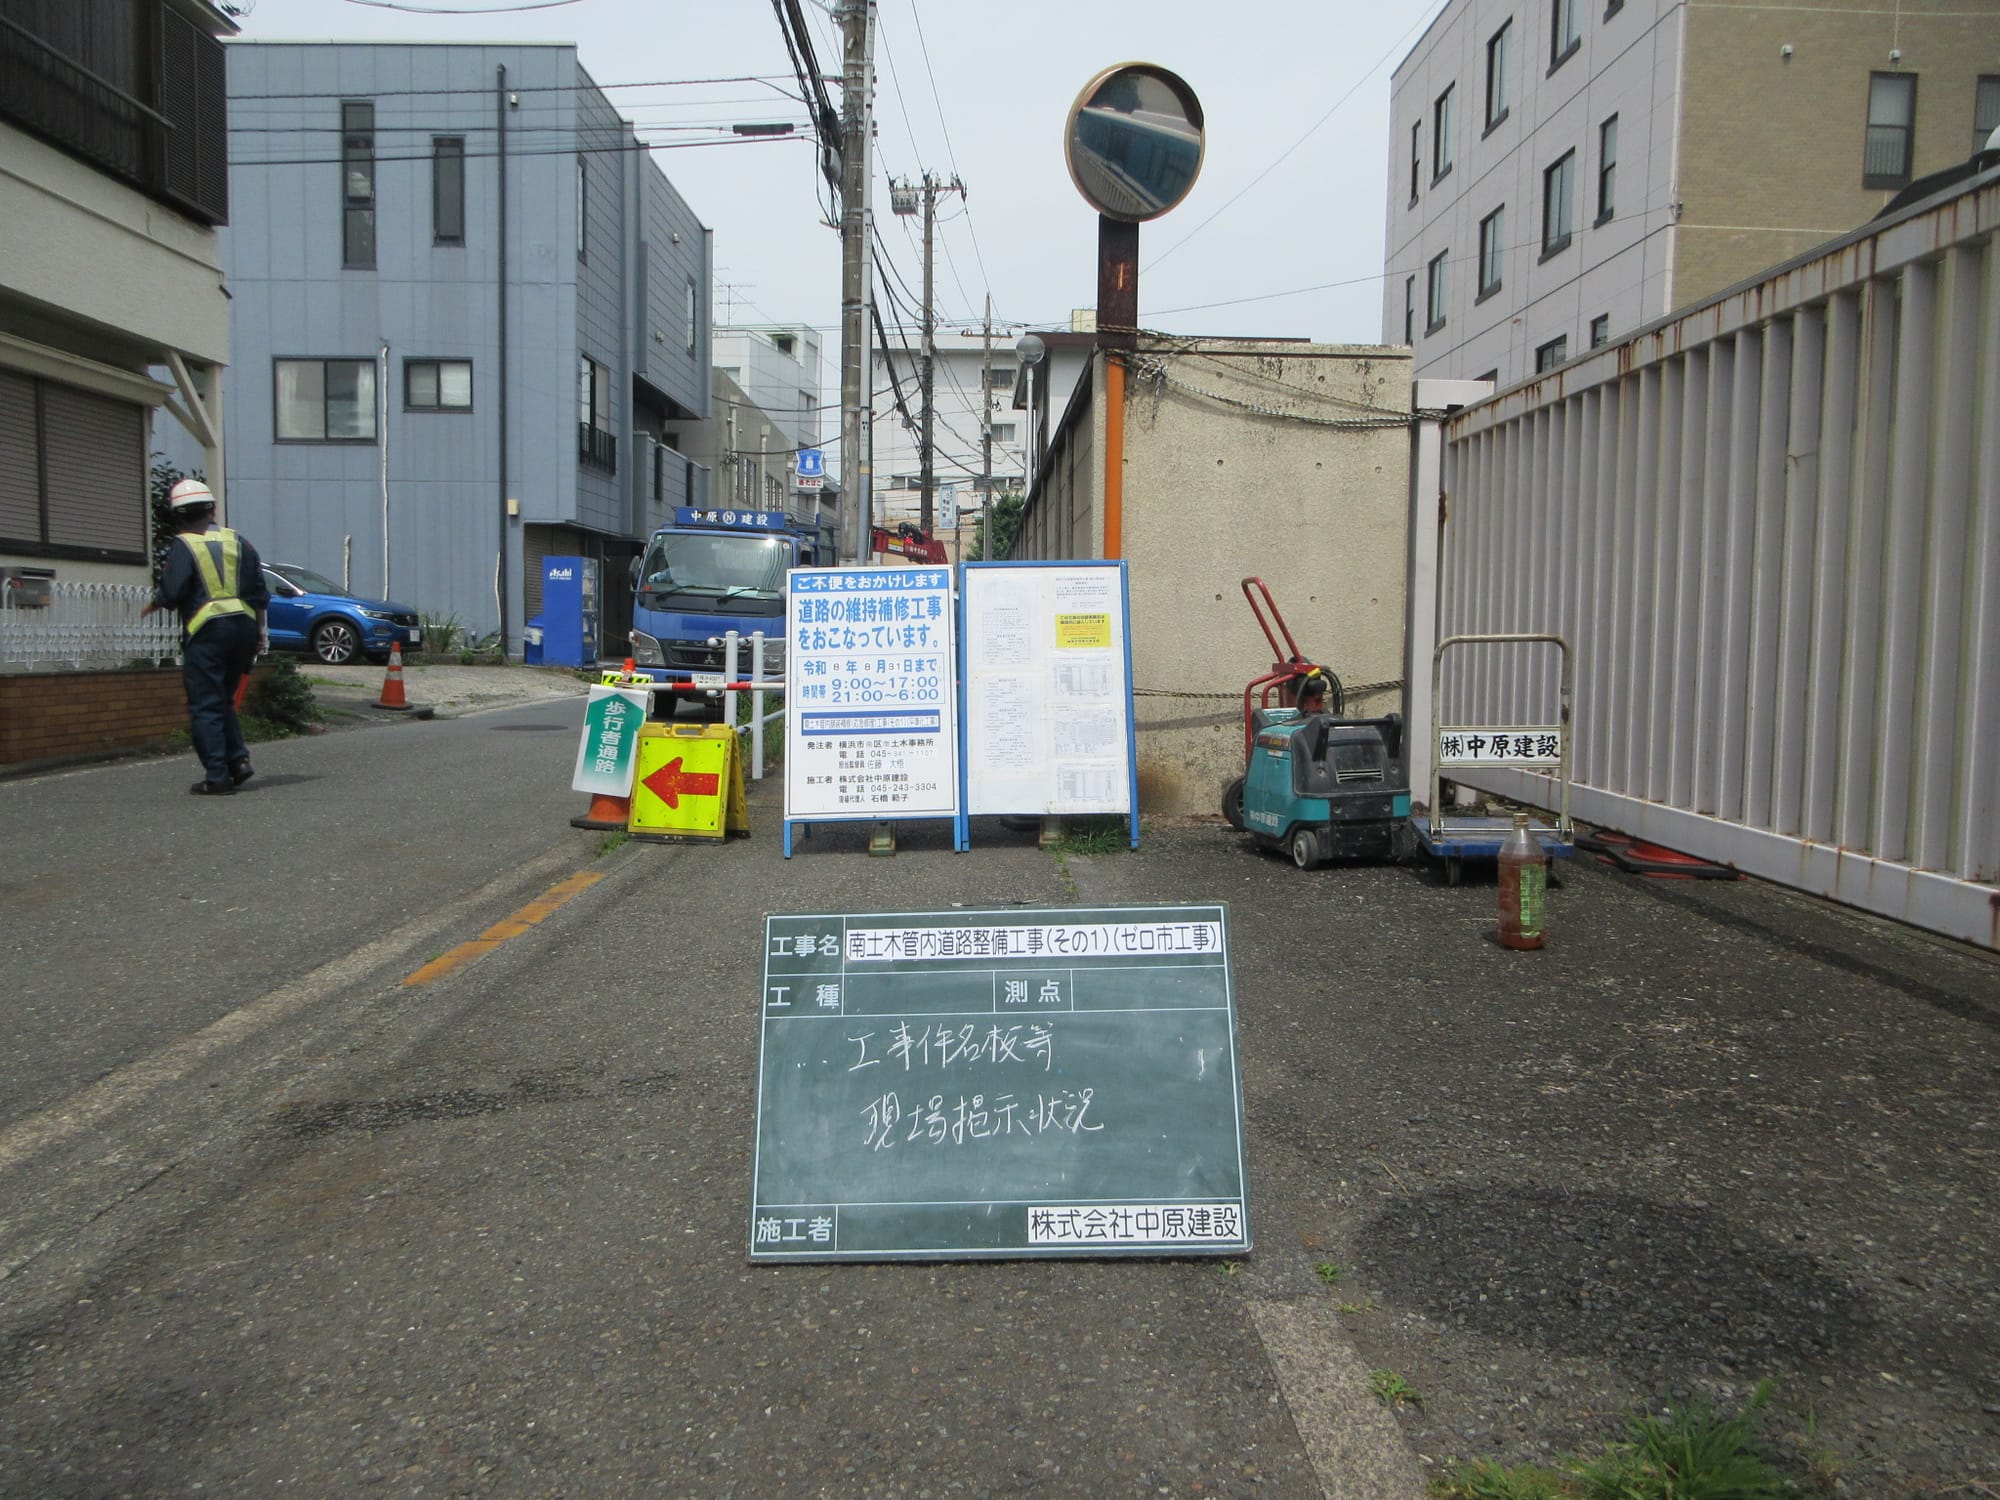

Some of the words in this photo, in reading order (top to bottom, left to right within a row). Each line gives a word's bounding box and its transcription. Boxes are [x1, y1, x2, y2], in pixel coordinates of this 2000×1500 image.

[691, 510, 718, 523] 中原
[741, 513, 768, 526] 建設
[550, 568, 572, 576] Asahi
[797, 574, 942, 591] ご不便をおかけします
[798, 595, 942, 623] 道路の維持補修工事
[798, 624, 938, 650] をおこなっています。
[802, 684, 826, 699] 時間帯
[595, 701, 626, 774] 歩行者通路
[807, 741, 833, 750] 発注者
[807, 775, 833, 784] 施工者
[839, 773, 909, 783] 株式会社中原建設
[870, 783, 937, 793] 045-243-3304
[871, 794, 888, 802] 石橋
[770, 935, 840, 958] 工事名
[1004, 979, 1061, 1004] 測点
[757, 1217, 833, 1242] 施工者
[1031, 1206, 1239, 1240] 株式会社中原建設
